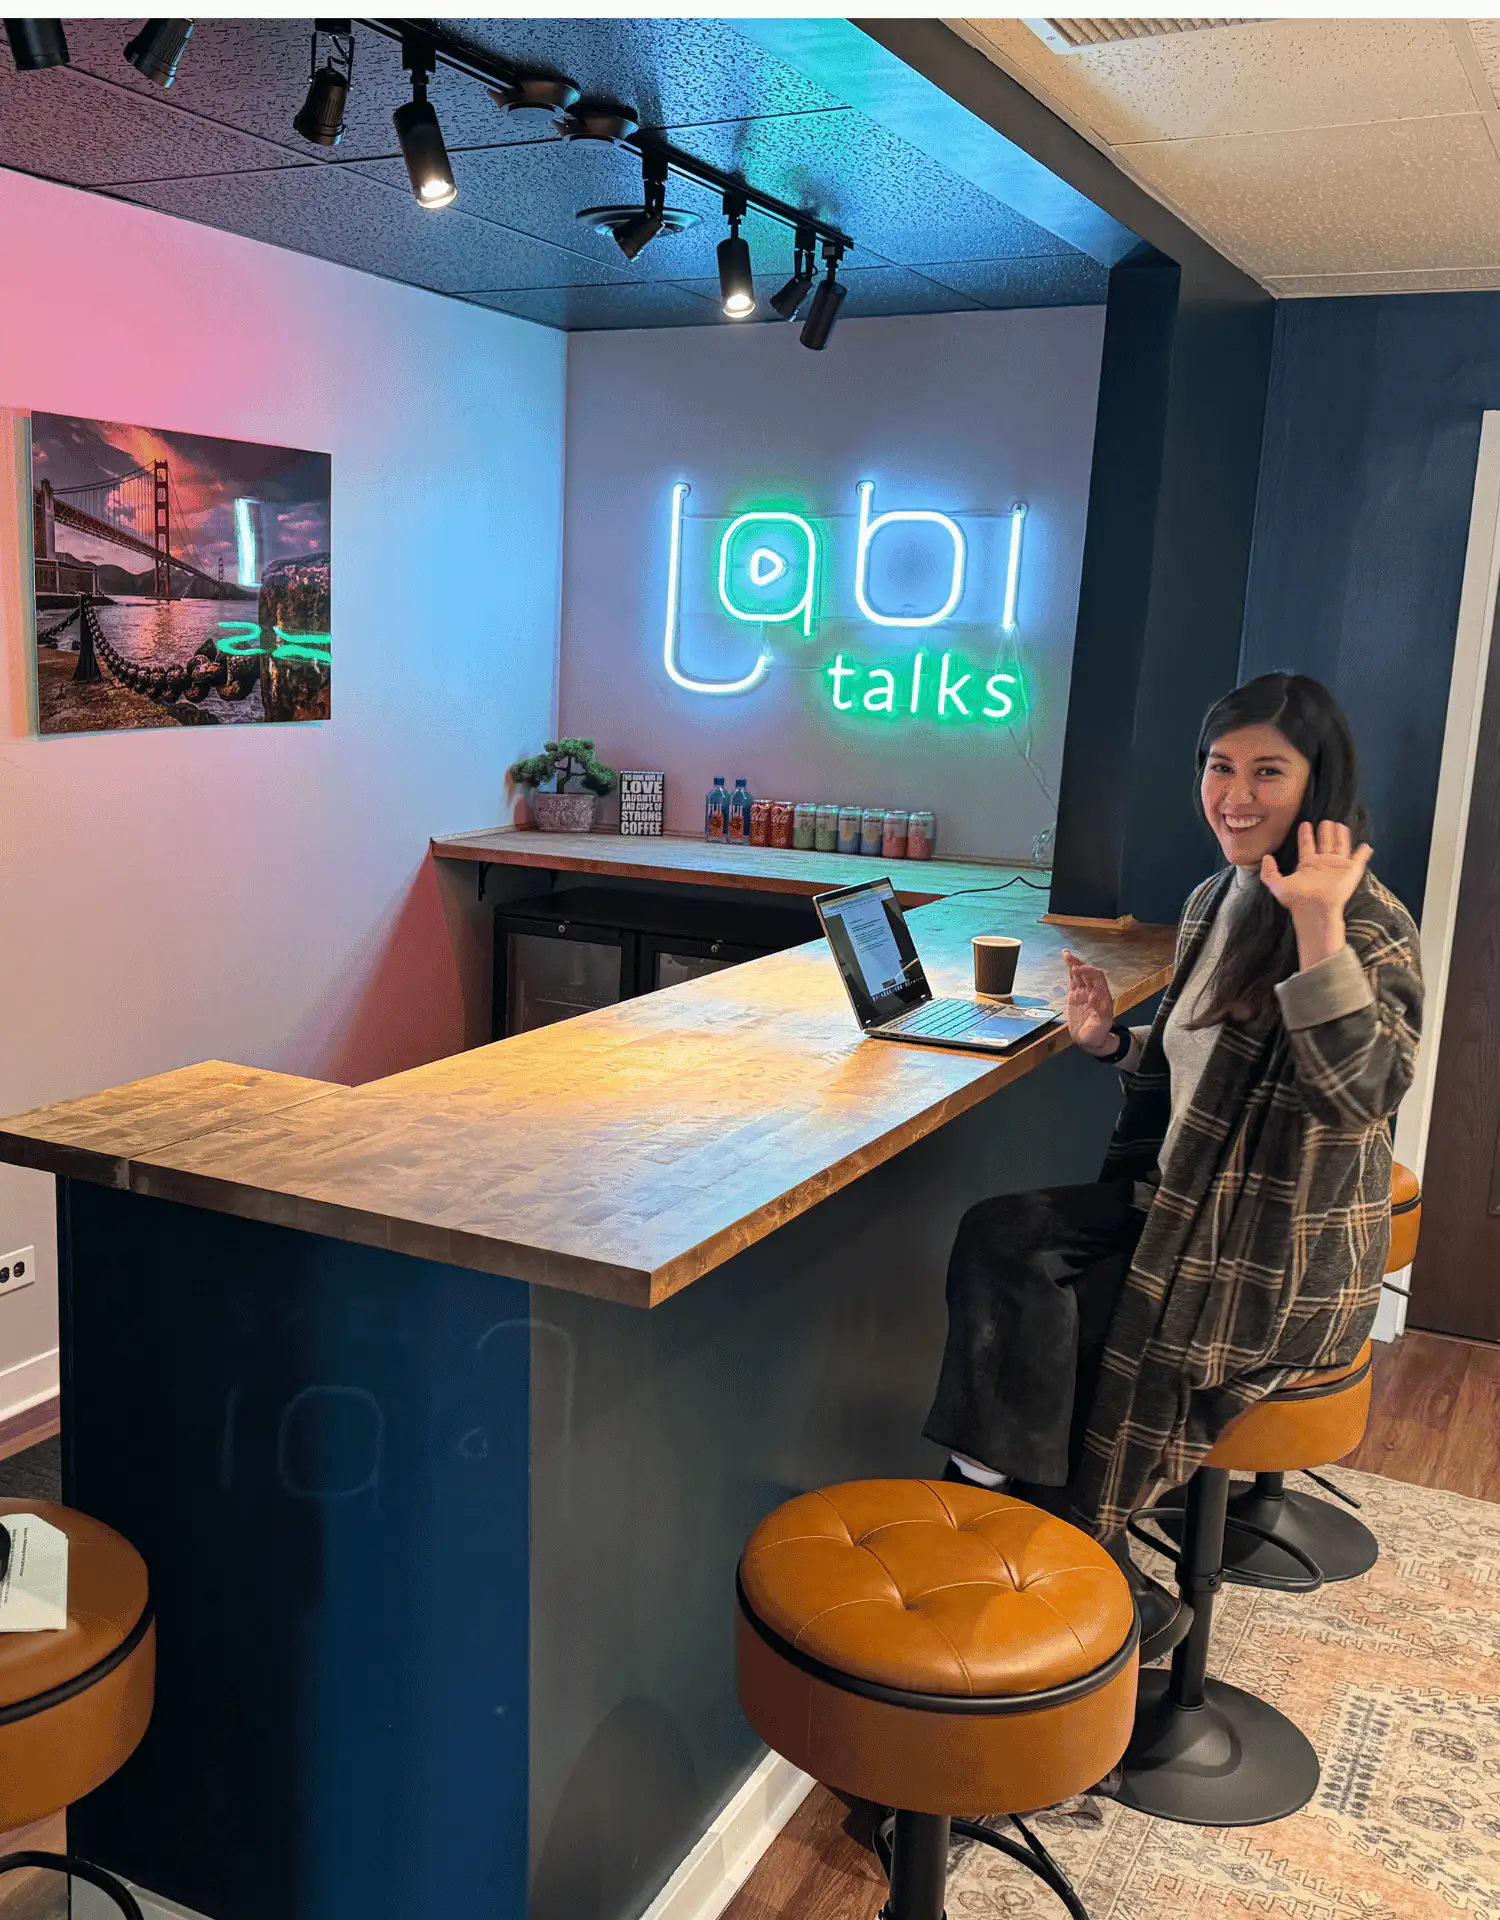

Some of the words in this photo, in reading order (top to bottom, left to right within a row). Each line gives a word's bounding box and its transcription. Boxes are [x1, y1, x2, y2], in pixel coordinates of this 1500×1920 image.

[826, 651, 1016, 718] talks
[621, 780, 663, 794] LOVE
[621, 793, 663, 803] LAUGHTER
[621, 802, 636, 811] AND
[636, 802, 654, 811] CUPS
[654, 802, 663, 811] OF
[621, 810, 662, 822] STRONG
[620, 821, 662, 836] COFFEE
